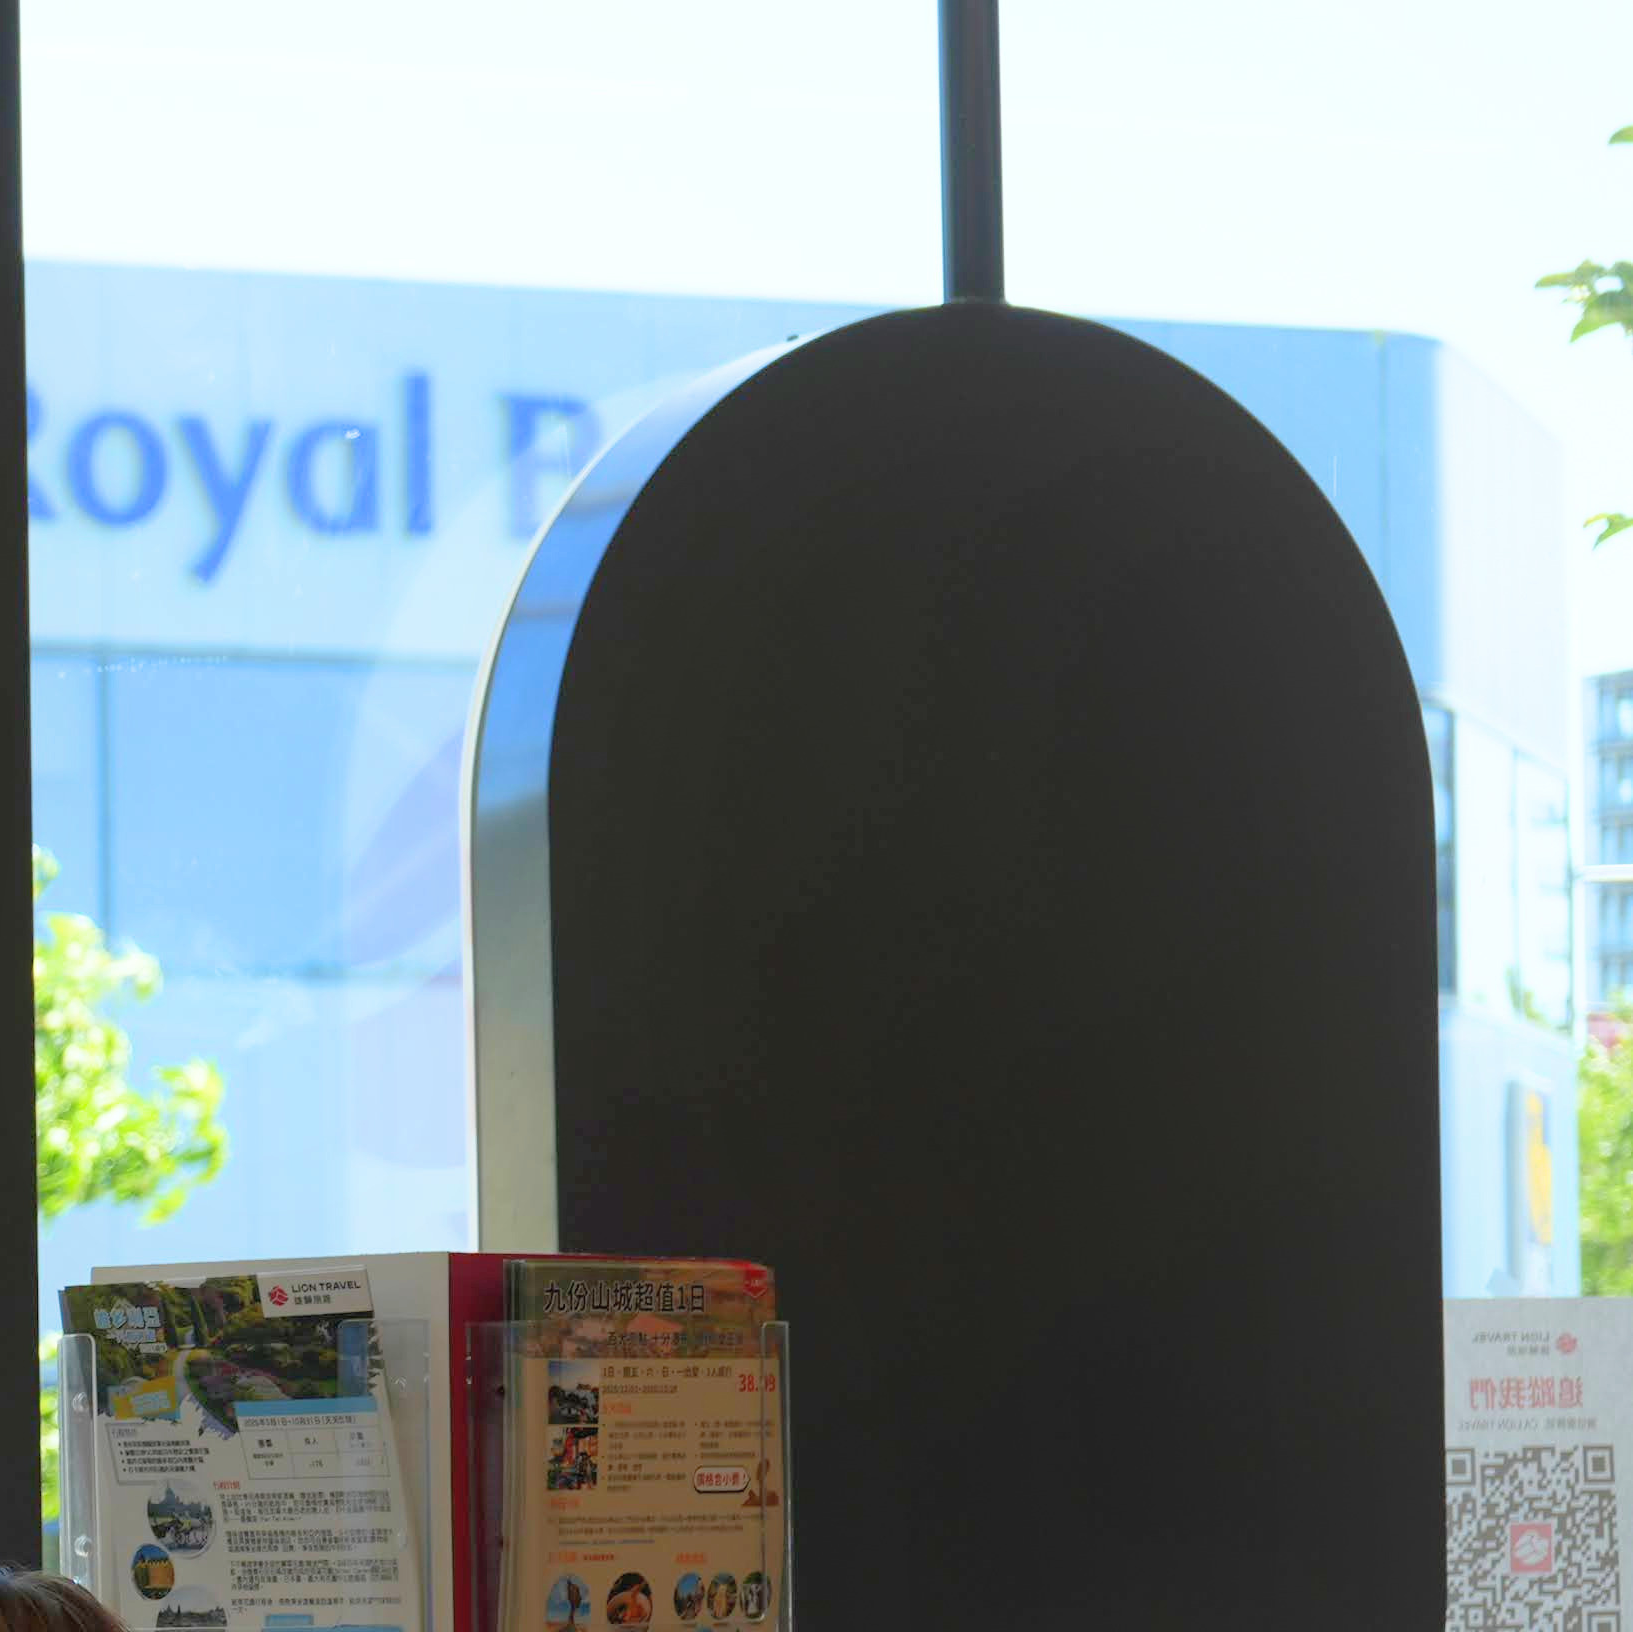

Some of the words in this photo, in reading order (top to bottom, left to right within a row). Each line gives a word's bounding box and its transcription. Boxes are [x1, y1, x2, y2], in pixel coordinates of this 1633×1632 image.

[291, 1282, 318, 1294] LION
[319, 1279, 362, 1291] TRAVEL
[543, 1280, 706, 1314] 九份山城超值1日
